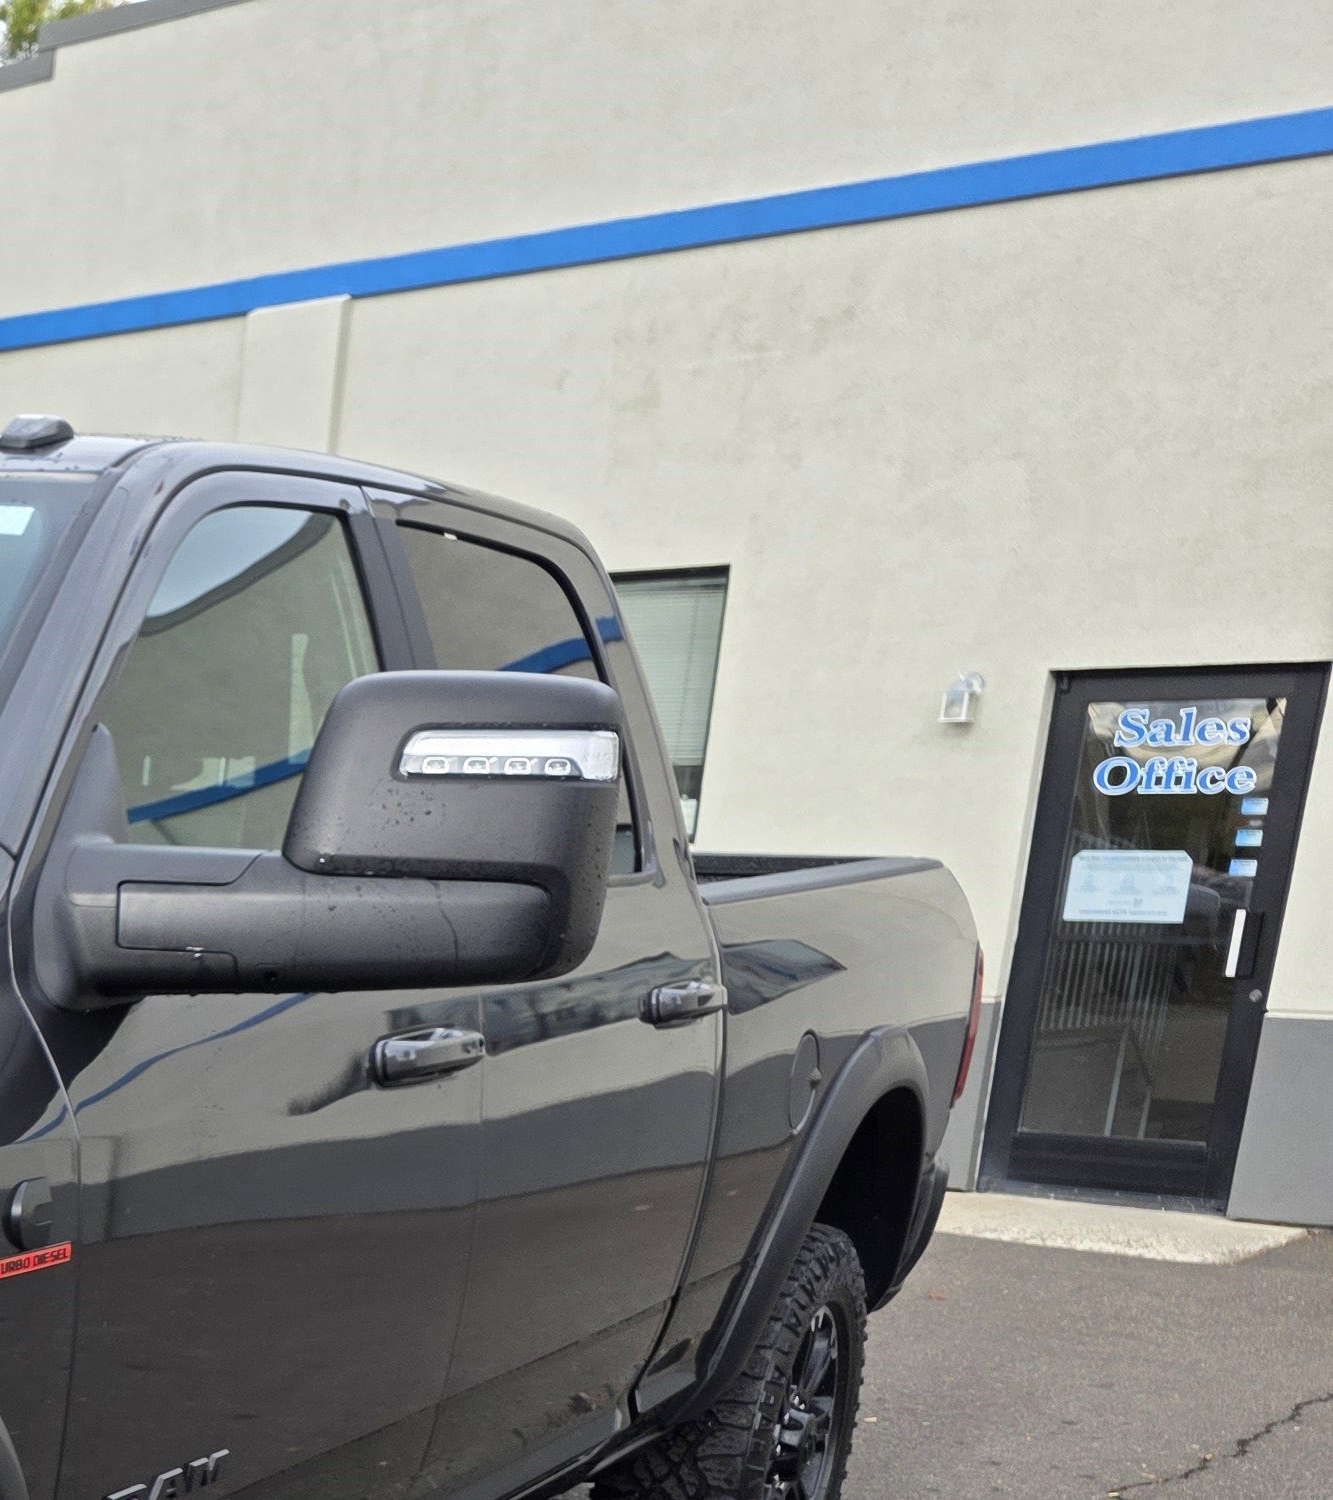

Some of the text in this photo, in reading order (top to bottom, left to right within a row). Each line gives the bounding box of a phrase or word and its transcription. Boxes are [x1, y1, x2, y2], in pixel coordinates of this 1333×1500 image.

[1114, 707, 1252, 748] Sales
[1093, 756, 1258, 796] Office
[33, 1247, 69, 1267] DIESEL
